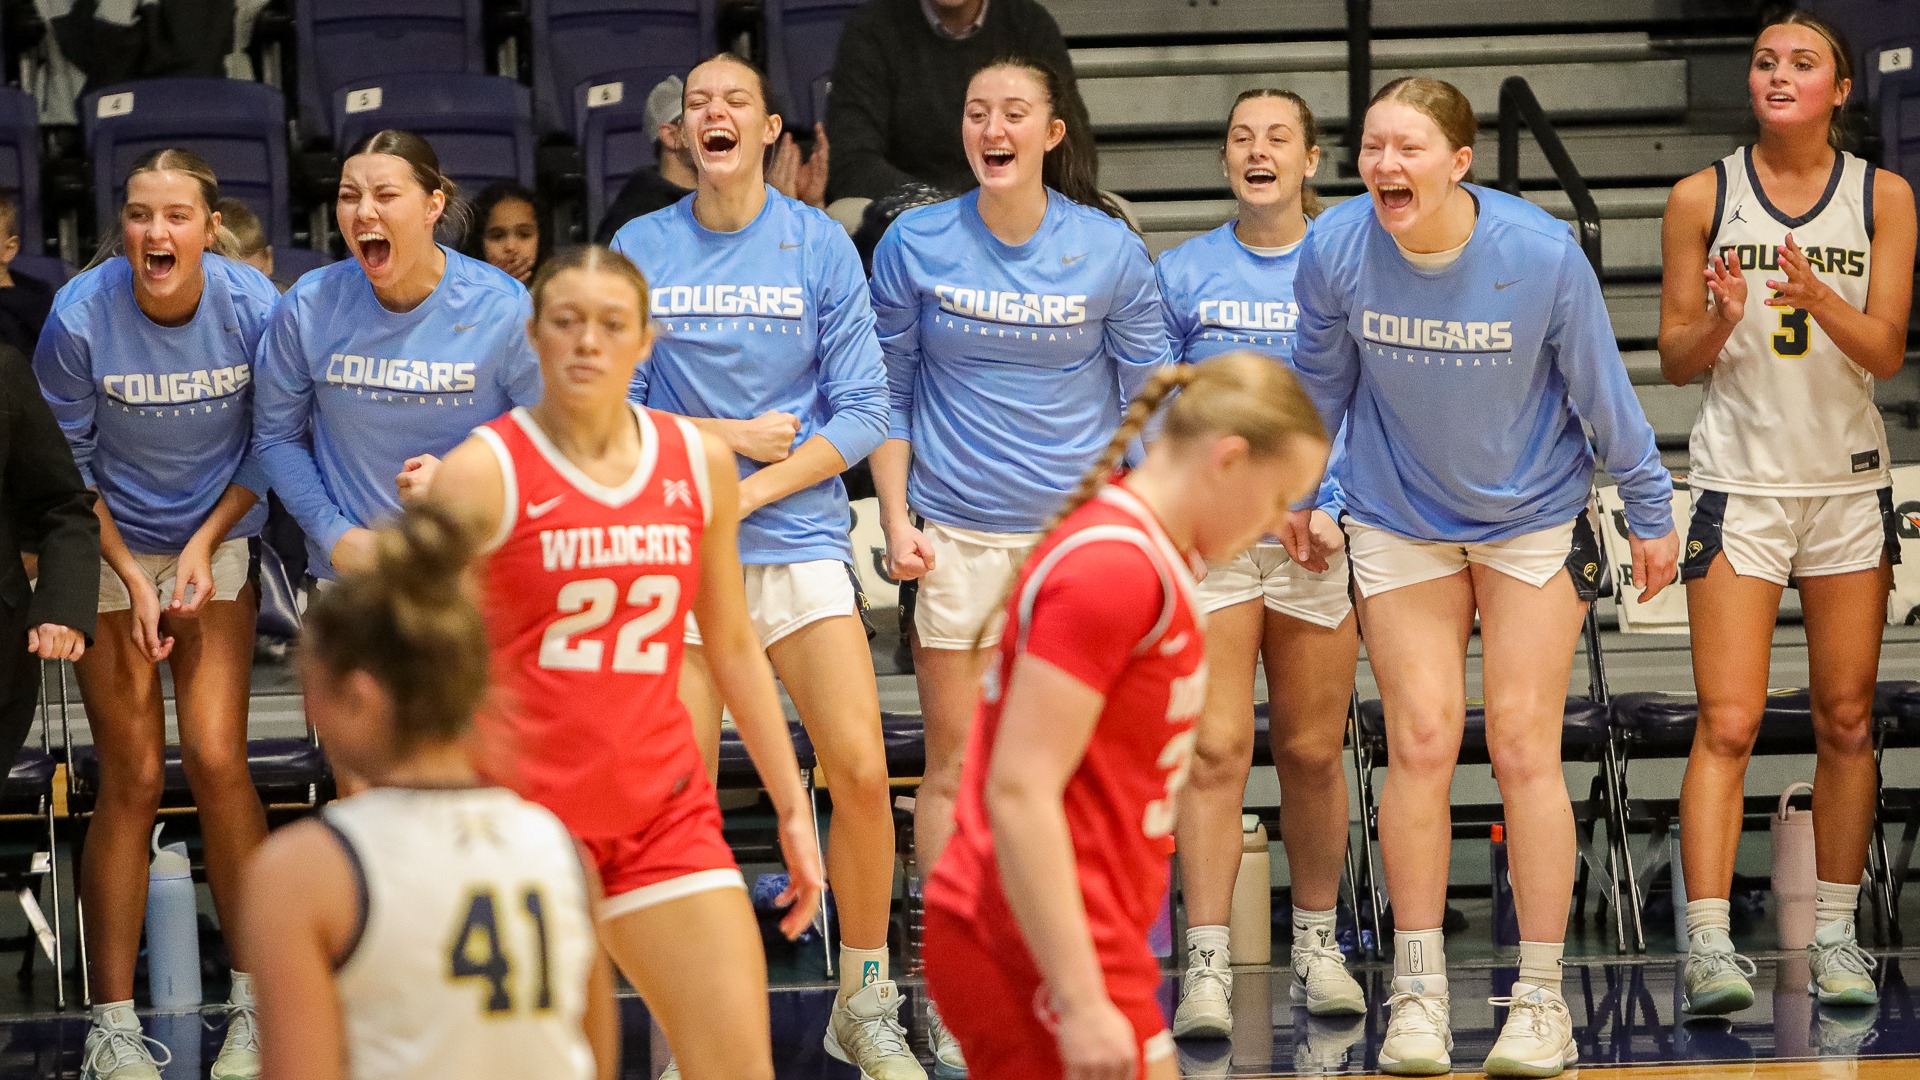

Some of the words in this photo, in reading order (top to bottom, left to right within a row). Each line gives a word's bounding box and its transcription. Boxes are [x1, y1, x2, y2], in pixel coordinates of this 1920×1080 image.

[1719, 244, 1866, 277] COUARS
[651, 284, 804, 316] COUGARS
[934, 284, 1087, 325] COUGARS
[666, 321, 802, 335] ASKETBALL
[935, 314, 1084, 342] BASKETBALL
[1363, 310, 1513, 350] COUGARS
[1771, 289, 1811, 359] 3
[103, 363, 250, 403] COUGARS
[326, 353, 476, 391] COUGARS
[331, 383, 474, 406] ASKETBALL
[540, 524, 693, 571] WILDCATS
[538, 574, 682, 674] 22
[443, 883, 555, 1018] 41
